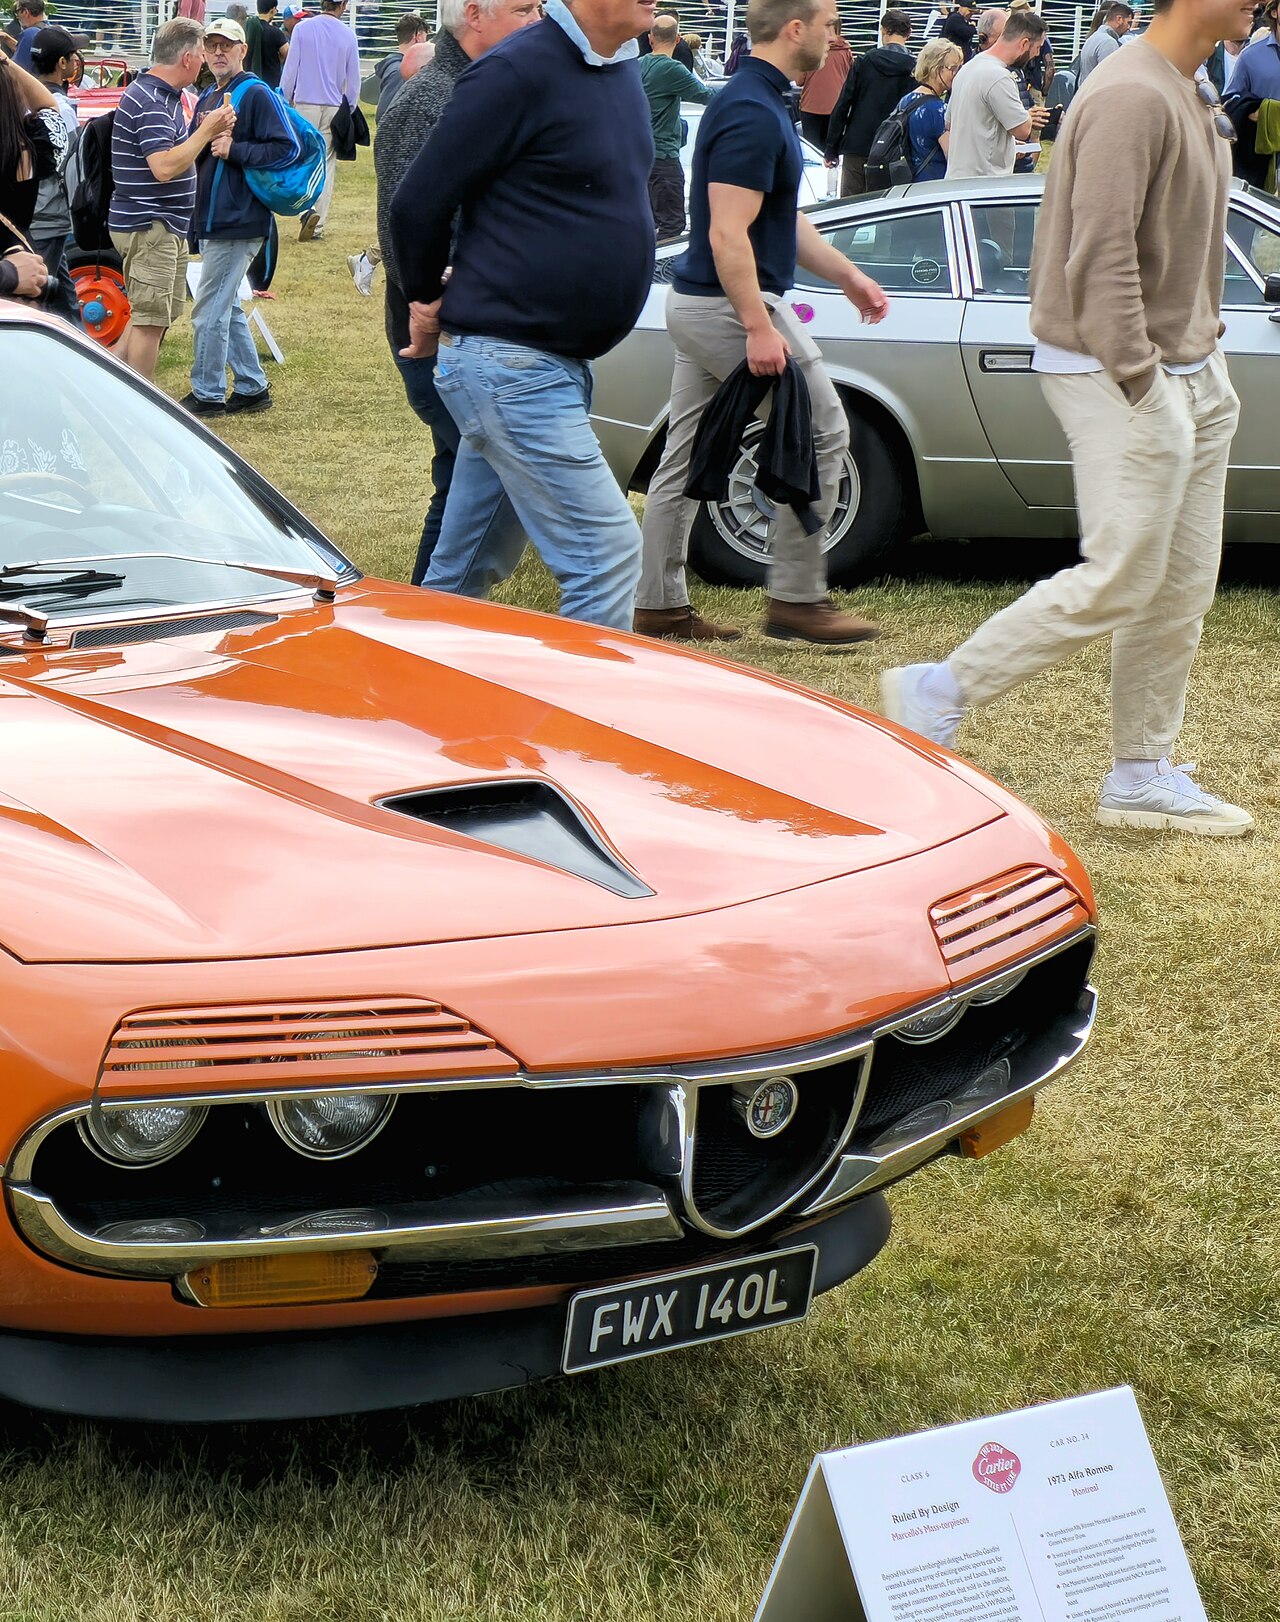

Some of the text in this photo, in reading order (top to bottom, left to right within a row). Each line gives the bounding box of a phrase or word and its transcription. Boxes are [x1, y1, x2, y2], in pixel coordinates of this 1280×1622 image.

[589, 1269, 788, 1353] FWX 140L
[1049, 1439, 1065, 1448] CAR
[1065, 1435, 1080, 1444] NO.
[978, 1458, 1016, 1476] Cartier
[1048, 1464, 1114, 1486] 1973 Alfa Romeo
[901, 1472, 923, 1484] CLASS
[983, 1476, 1000, 1492] STYLE
[1004, 1470, 1016, 1487] LUXE
[1071, 1483, 1099, 1497] Montreal
[892, 1501, 960, 1524] Ruled By Design
[891, 1526, 923, 1541] Marcello's
